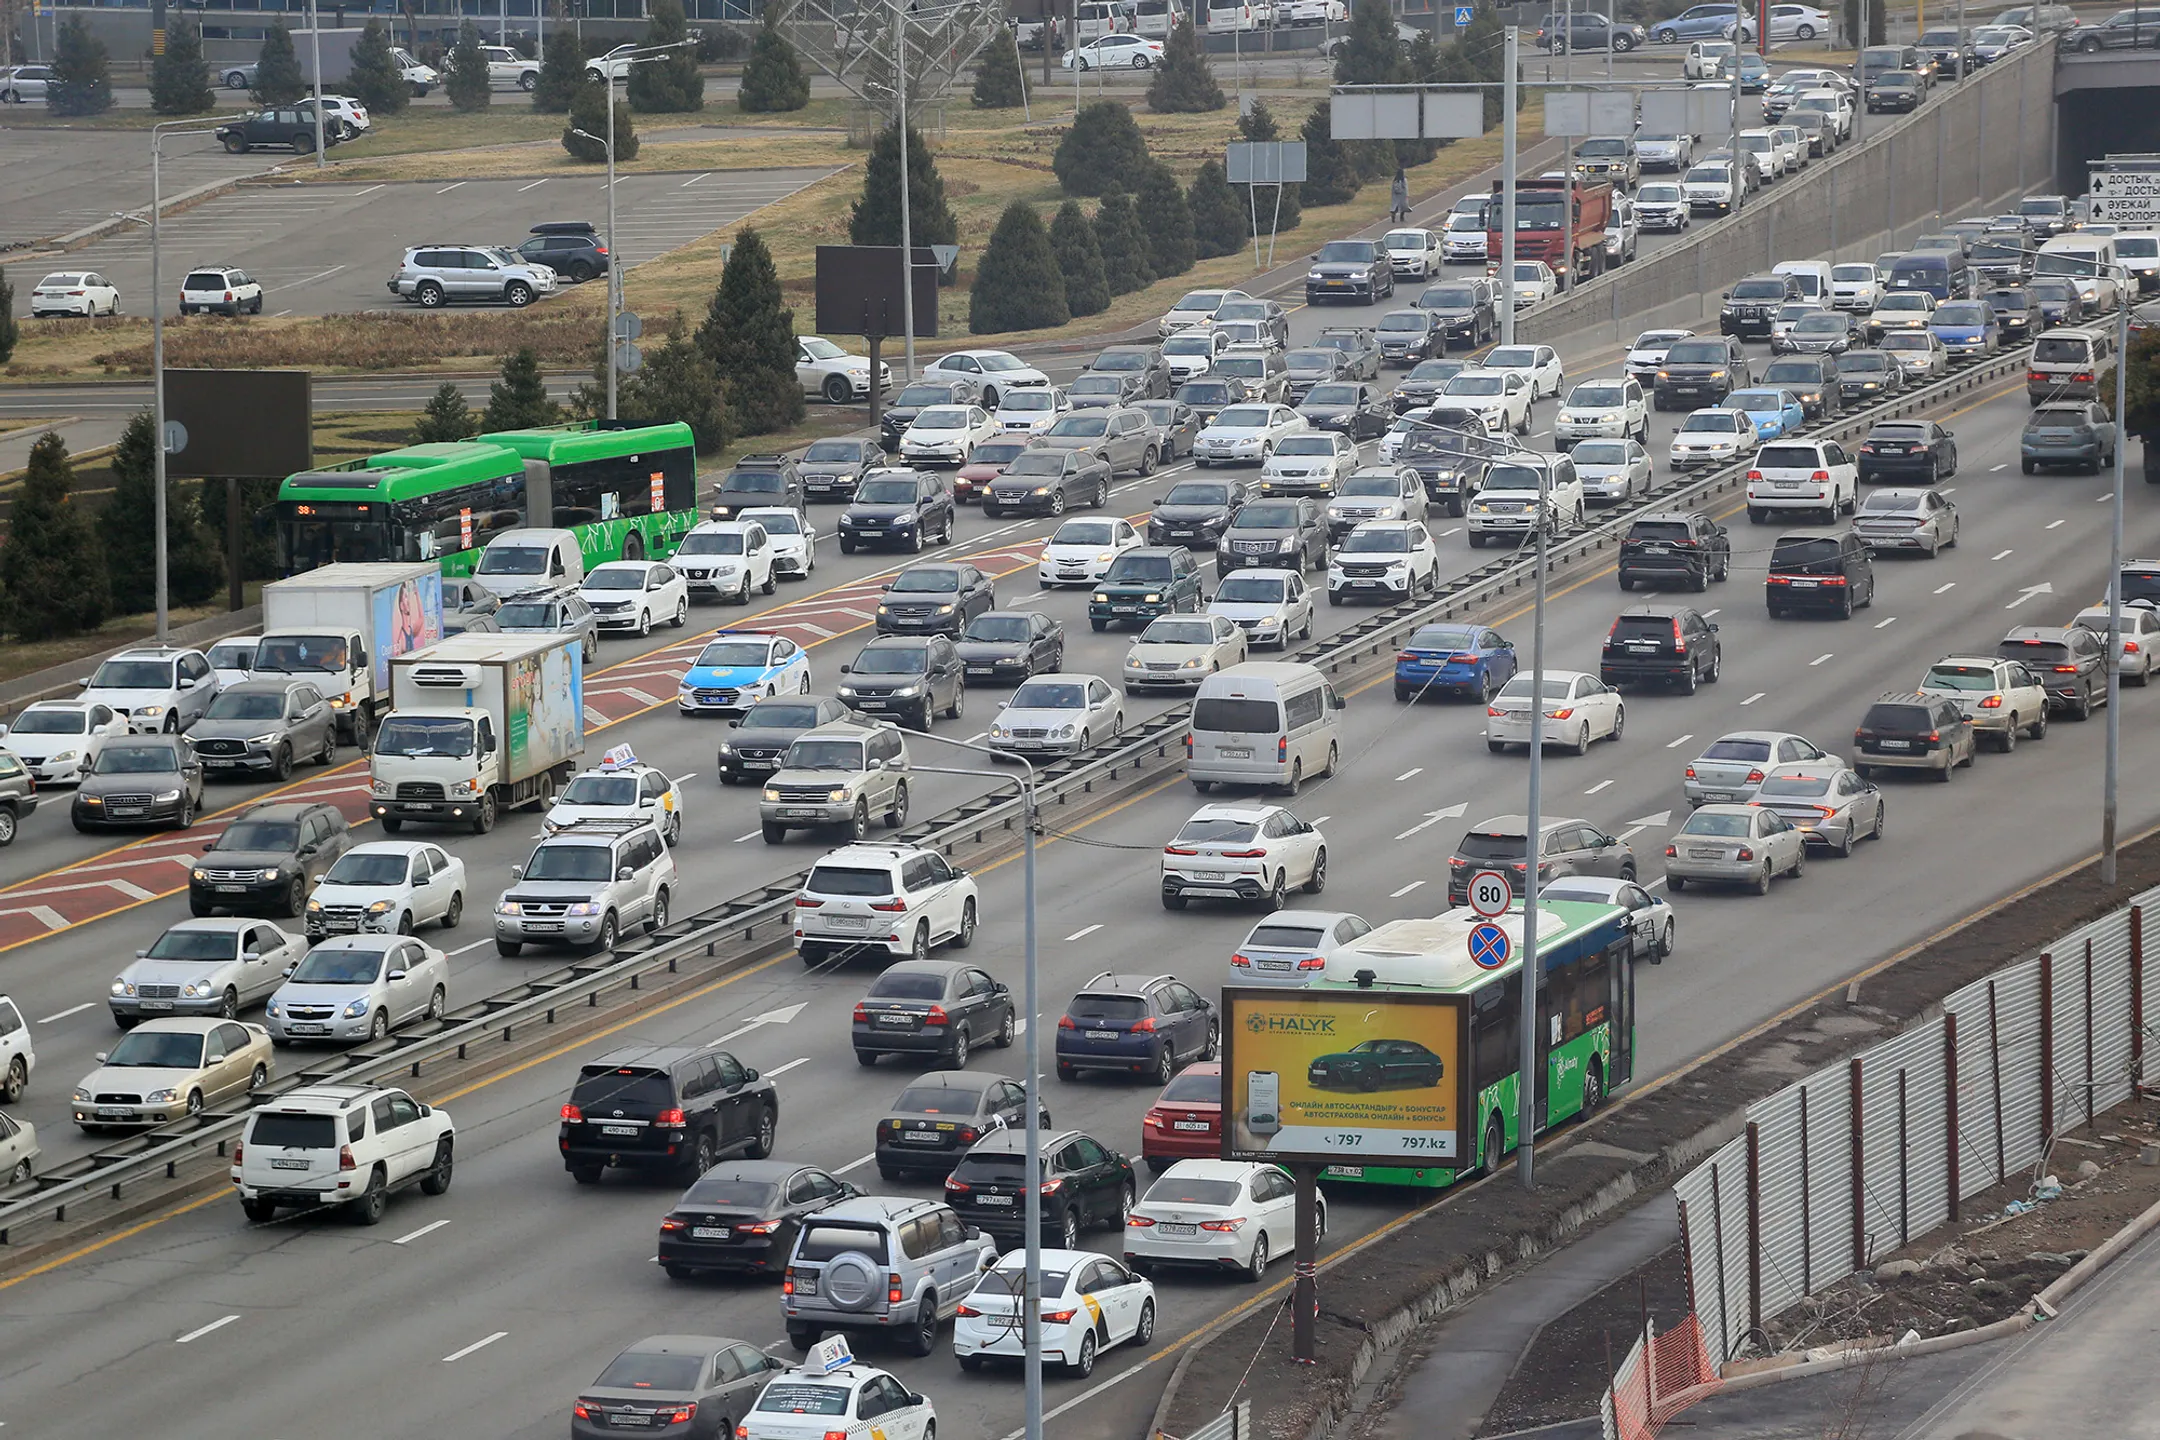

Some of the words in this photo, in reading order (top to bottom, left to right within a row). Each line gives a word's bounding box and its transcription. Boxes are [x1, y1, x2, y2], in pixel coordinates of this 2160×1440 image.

[2108, 199, 2150, 209] ӘУЕЖАЙ
[2108, 211, 2160, 220] АЭРОПОРТ
[1479, 886, 1500, 903] 80
[1269, 1017, 1335, 1032] HALYK
[1290, 1101, 1322, 1109] ОНЛАЙН
[1371, 1113, 1404, 1121] ОНЛАЙН
[1338, 1134, 1362, 1146] 797
[1401, 1137, 1446, 1149] 797.kz
